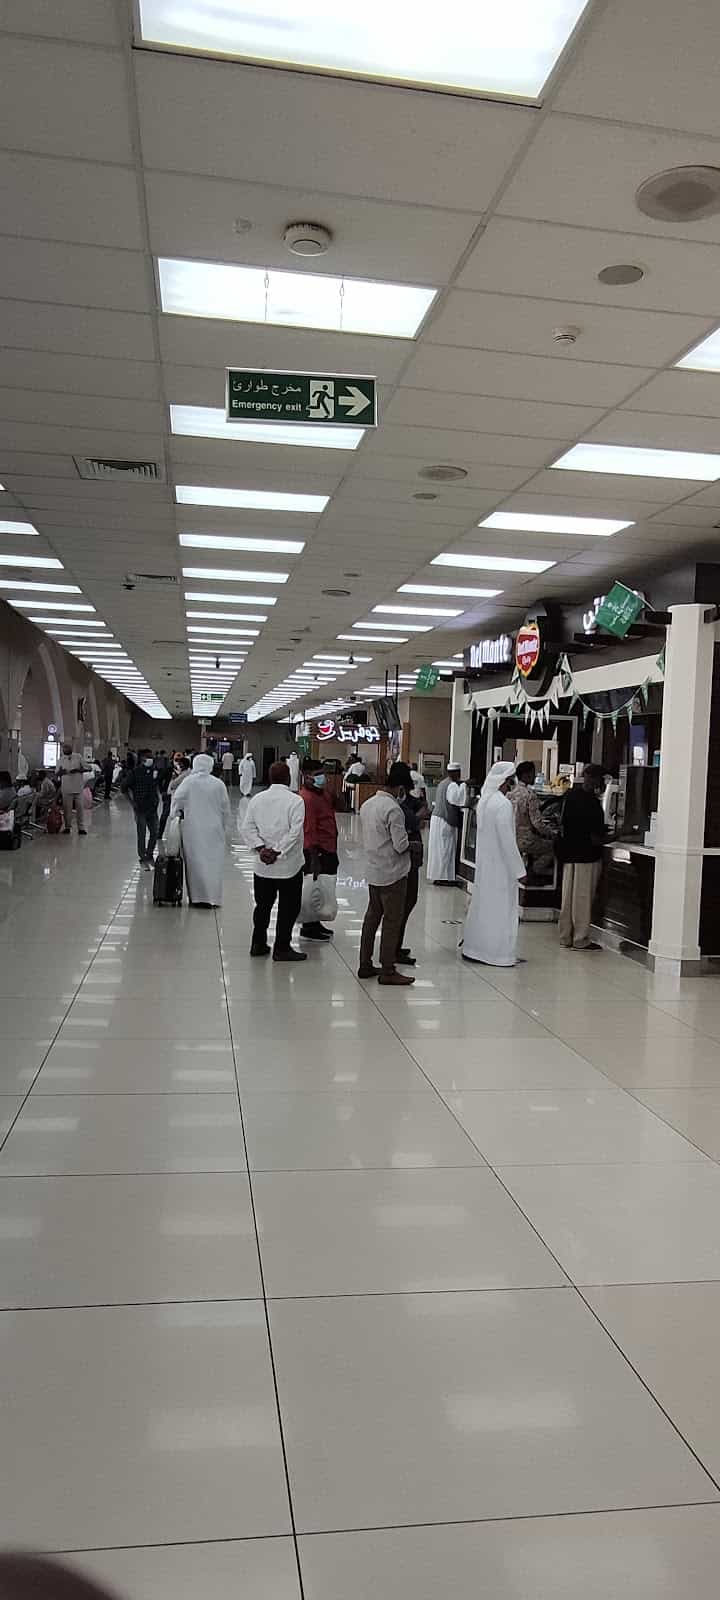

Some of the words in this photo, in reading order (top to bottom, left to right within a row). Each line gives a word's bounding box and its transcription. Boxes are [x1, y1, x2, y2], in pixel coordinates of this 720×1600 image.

[232, 378, 269, 393] طوارئ
[271, 383, 302, 396] مخرج
[231, 399, 282, 412] Emergency
[285, 402, 302, 411] exit
